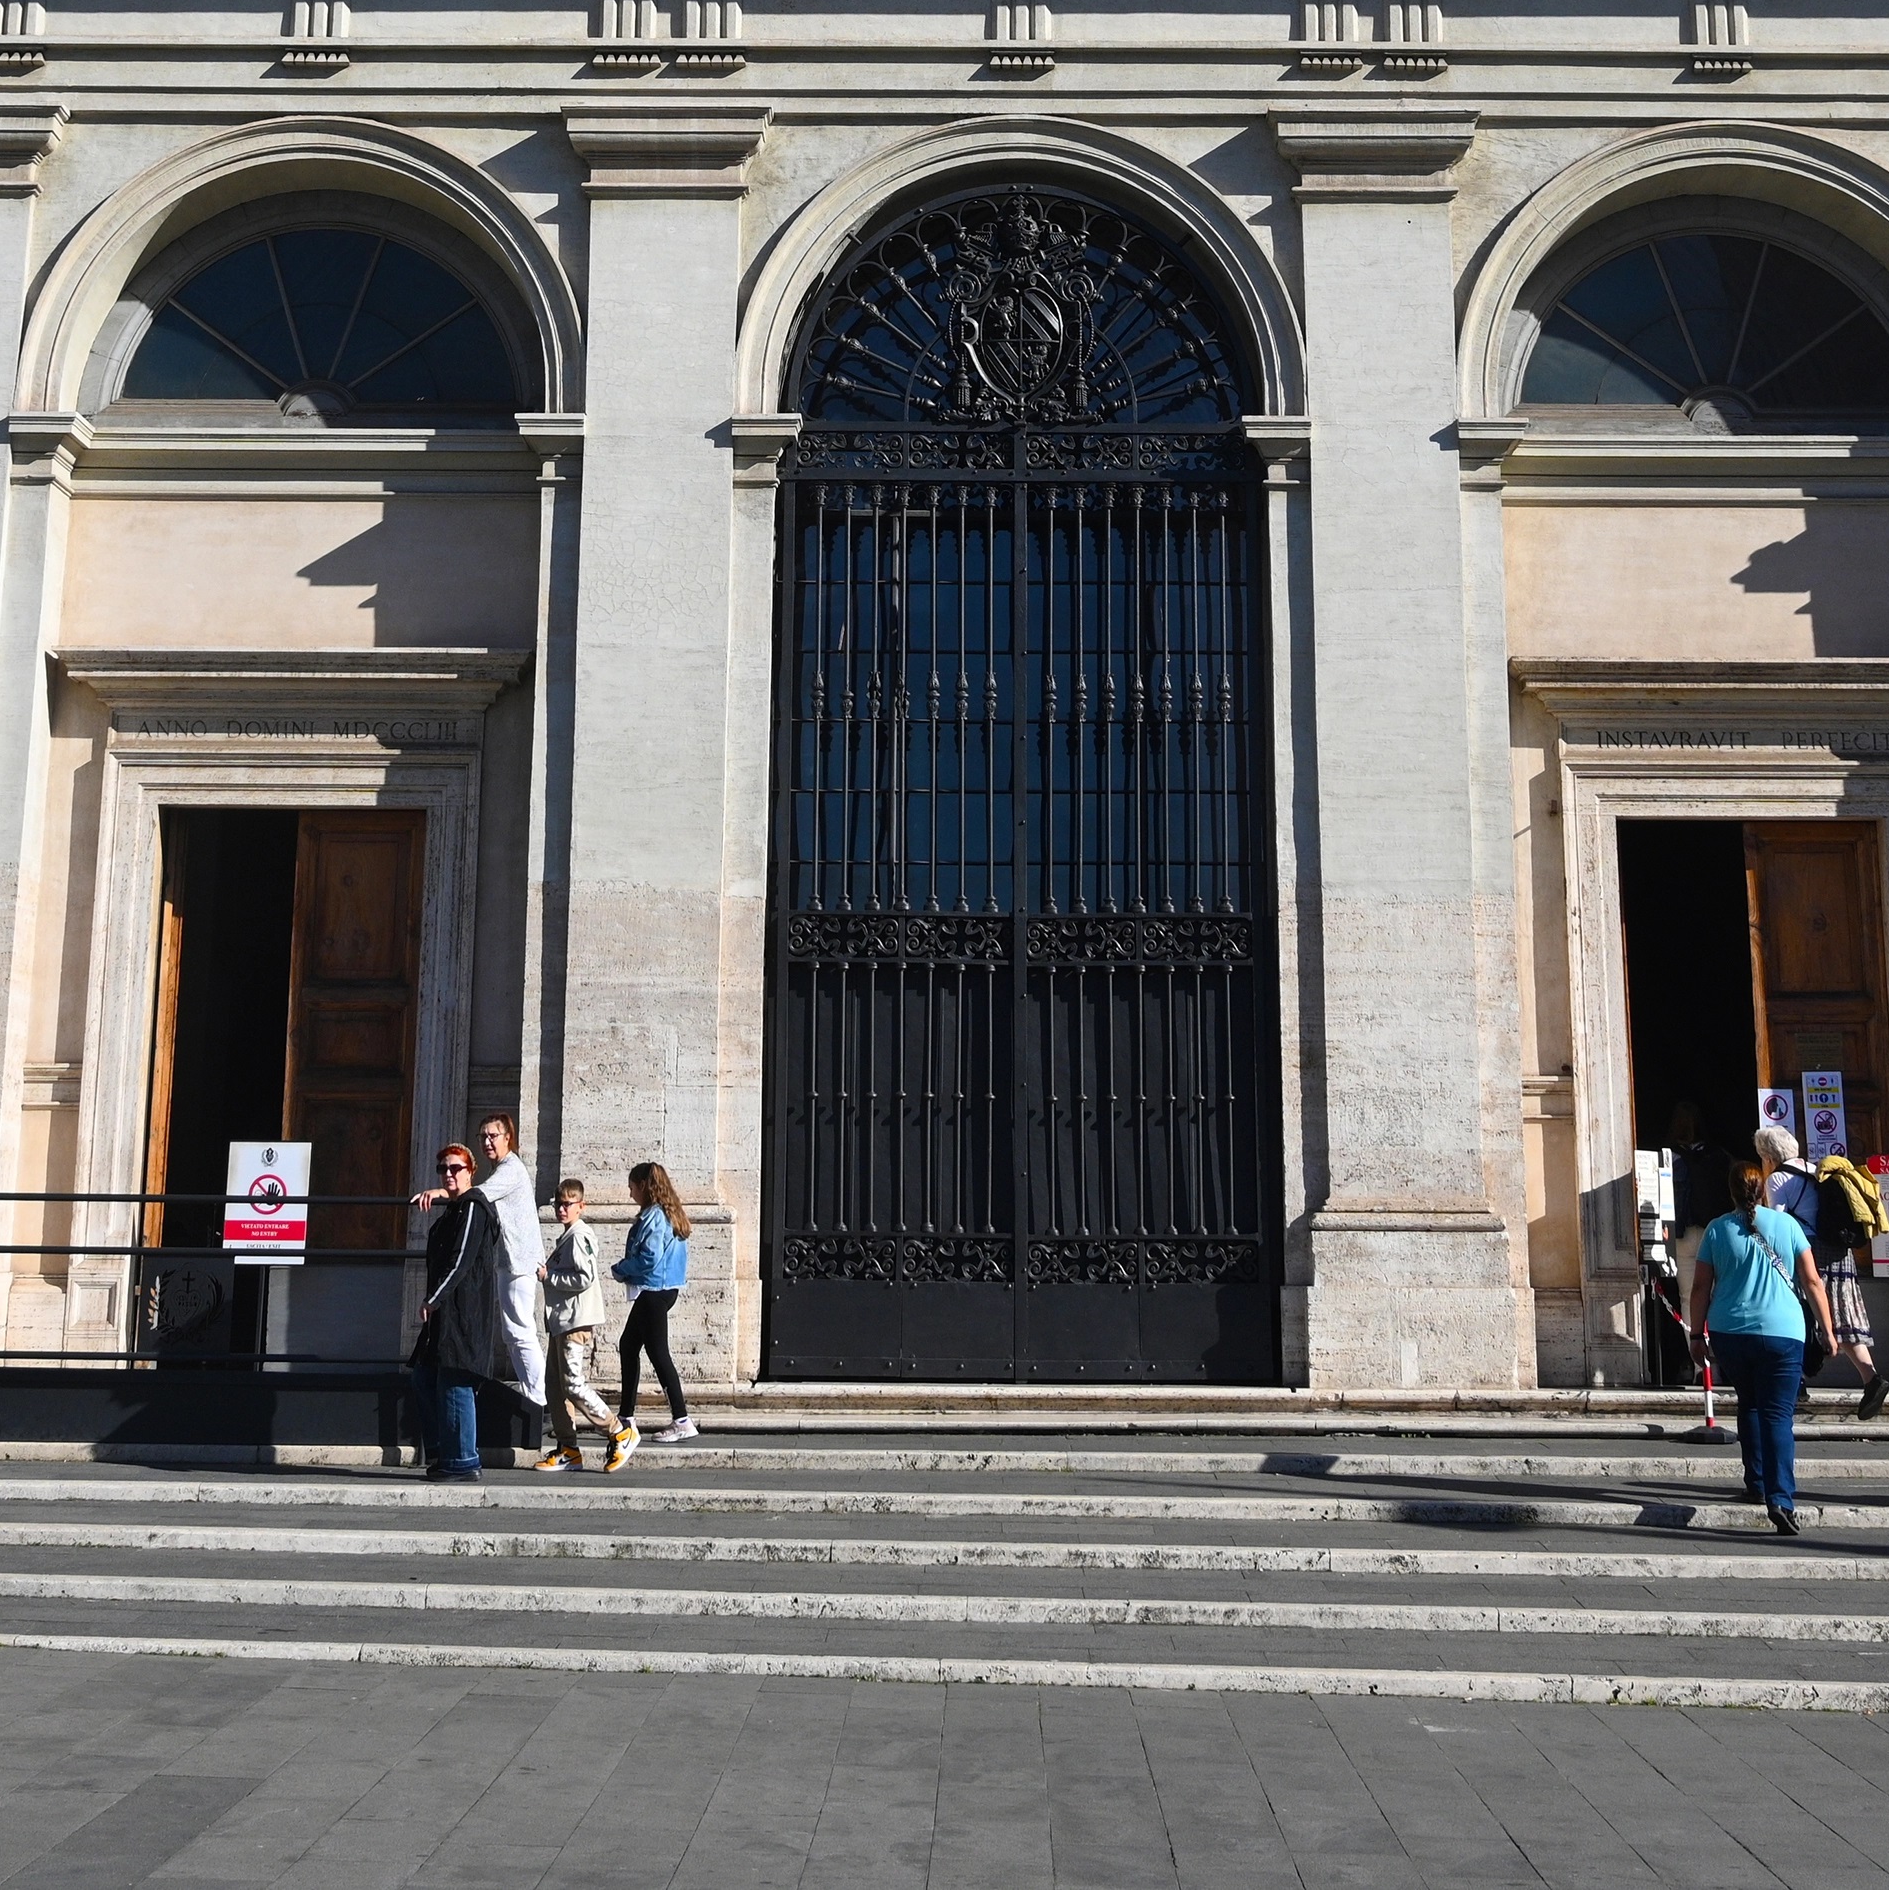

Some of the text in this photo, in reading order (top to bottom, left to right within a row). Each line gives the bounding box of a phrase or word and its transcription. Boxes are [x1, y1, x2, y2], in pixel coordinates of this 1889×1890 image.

[135, 719, 208, 739] ANNO
[226, 720, 315, 740] DOMINI
[1596, 730, 1751, 750] INSTAVRAVIT
